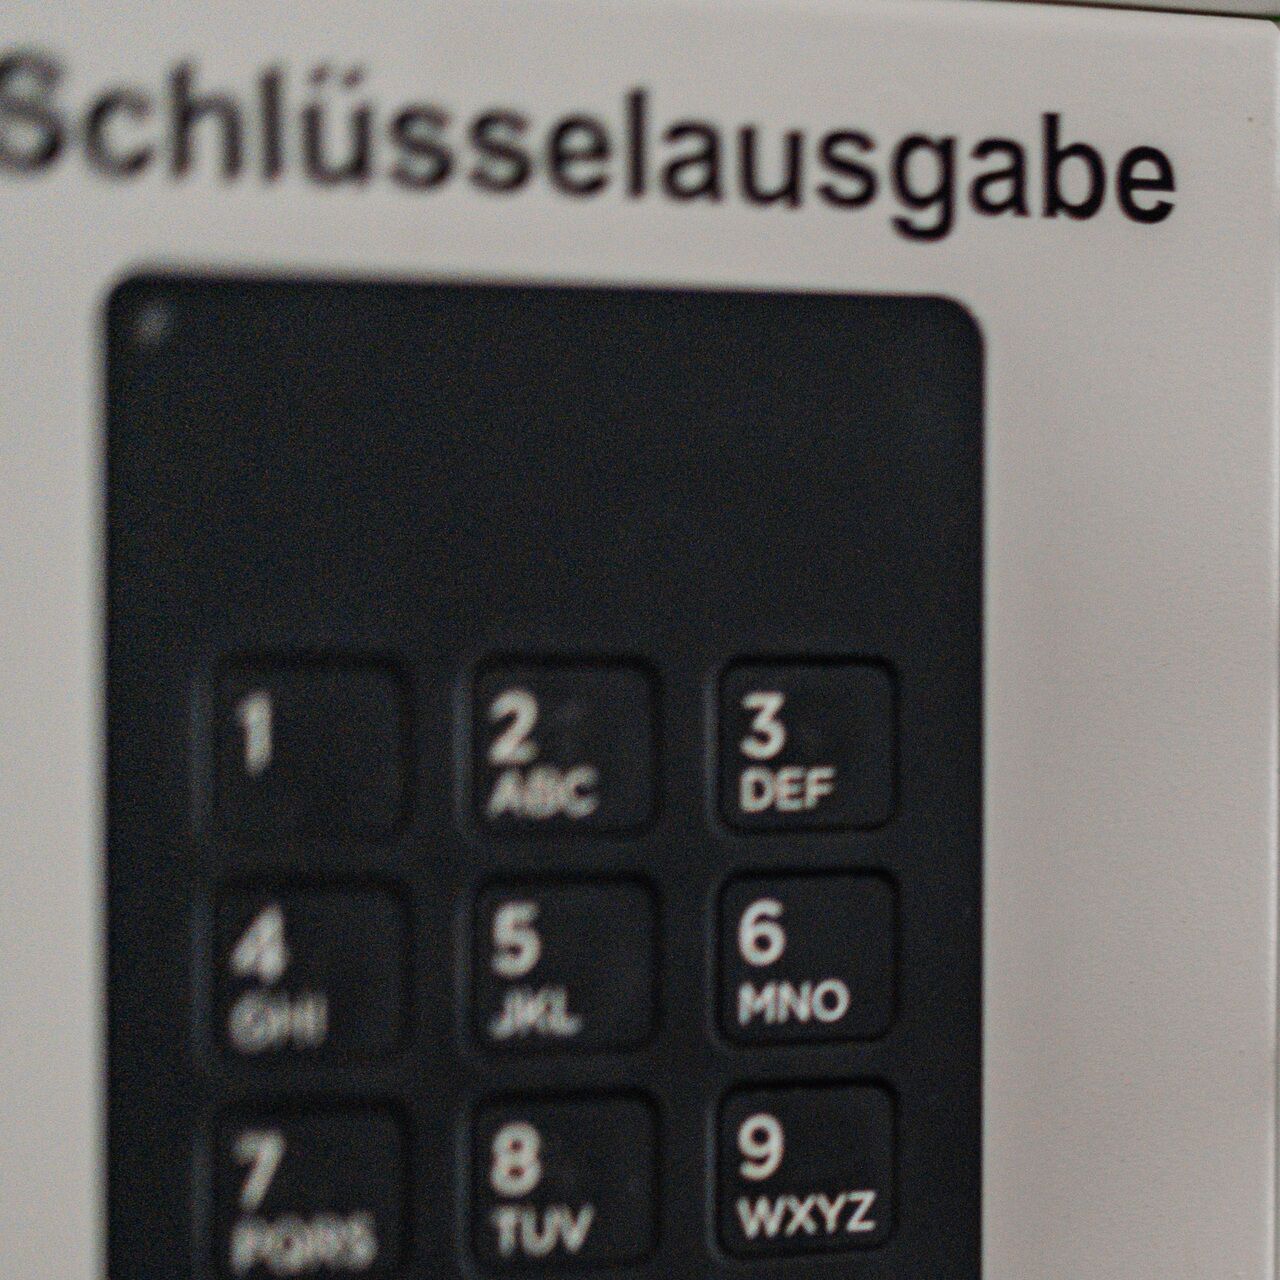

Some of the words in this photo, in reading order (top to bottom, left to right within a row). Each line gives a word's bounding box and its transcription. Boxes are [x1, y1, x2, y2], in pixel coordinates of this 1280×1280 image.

[0, 46, 1179, 246] Schlüsselausgabe
[236, 690, 274, 772] 1
[489, 688, 539, 765] 2
[740, 690, 787, 761] 3
[488, 765, 598, 819] ABC
[738, 765, 835, 814] DEF
[232, 907, 287, 982] 4
[492, 902, 542, 977] 5
[737, 897, 787, 967] 6
[492, 990, 580, 1038] JKL
[736, 977, 851, 1024] MNO
[236, 1131, 285, 1208] 7
[490, 1122, 543, 1197] 8
[736, 1112, 786, 1181] 9
[492, 1205, 594, 1256] TUV
[736, 1188, 877, 1239] WXYZ
